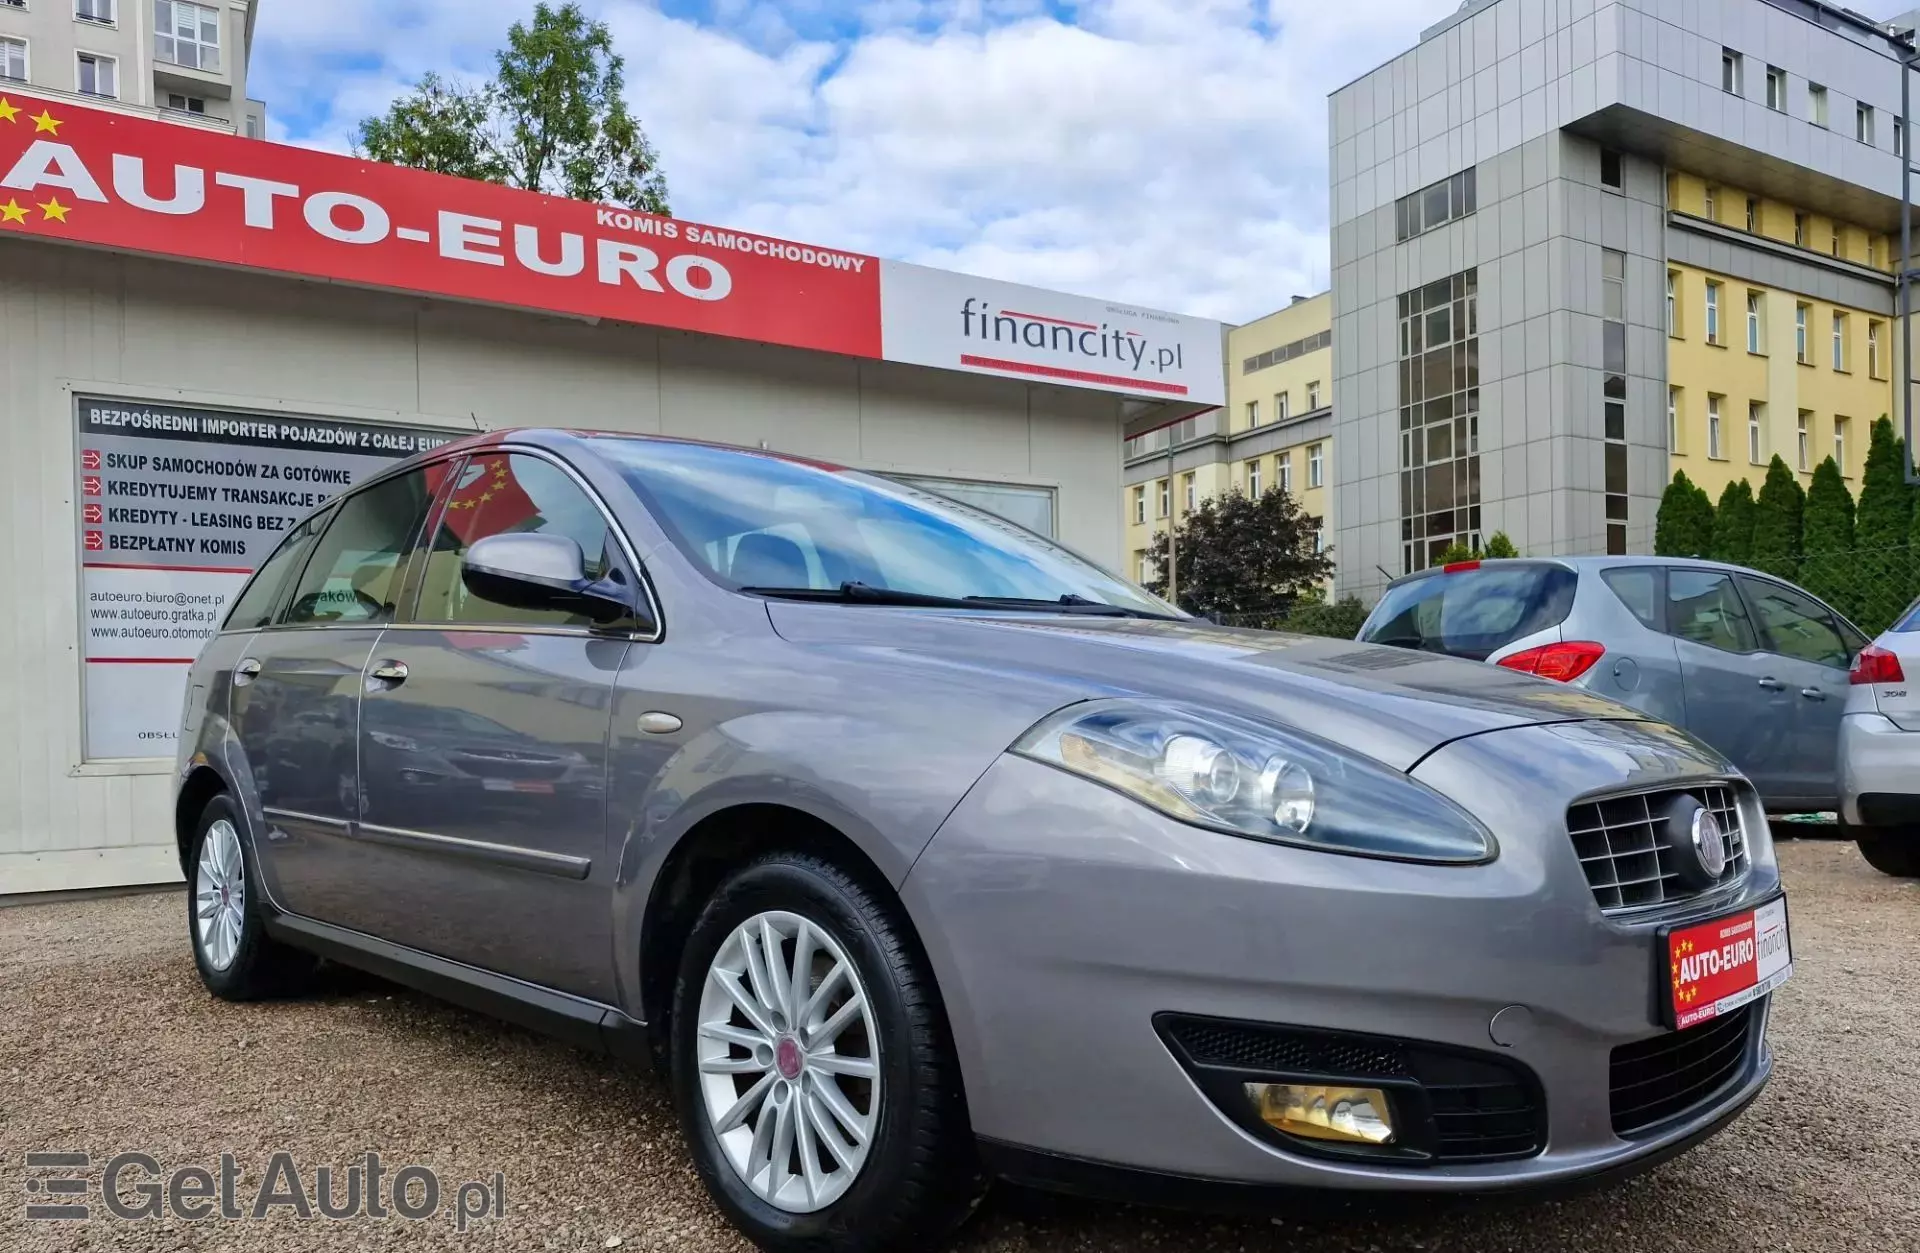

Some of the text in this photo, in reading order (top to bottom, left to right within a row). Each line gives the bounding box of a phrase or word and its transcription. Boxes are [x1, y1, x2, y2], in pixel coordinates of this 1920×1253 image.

[0, 139, 732, 301] AUTO-EURO
[597, 209, 866, 273] KOMIS SAMOCHODOWY
[961, 298, 1183, 373] financity.pl
[90, 408, 198, 433] BEZPOŚREDNI
[202, 418, 277, 439] IMPORTER
[281, 426, 356, 446] POJAZDÓW
[360, 432, 369, 447] Z
[372, 434, 414, 450] CAŁEJ
[107, 453, 351, 486] SKUP SAMOCHODÓW ZA GOTÓWKĘ
[107, 480, 217, 501] KREDYTUJEMY
[222, 488, 313, 507] TRANSAKCJE
[109, 508, 178, 525] KREDYTY
[191, 512, 252, 530] LEASING
[257, 516, 283, 531] BEZ
[109, 534, 246, 555] BEZPŁATNY KOMIS
[90, 592, 225, 607] autoeuro.biuro@onet.pl
[90, 607, 217, 624] www.autoeuro.gratka.pl
[1680, 937, 1754, 985] AUTO-EURO
[1681, 1006, 1715, 1026] AUTO-EURO
